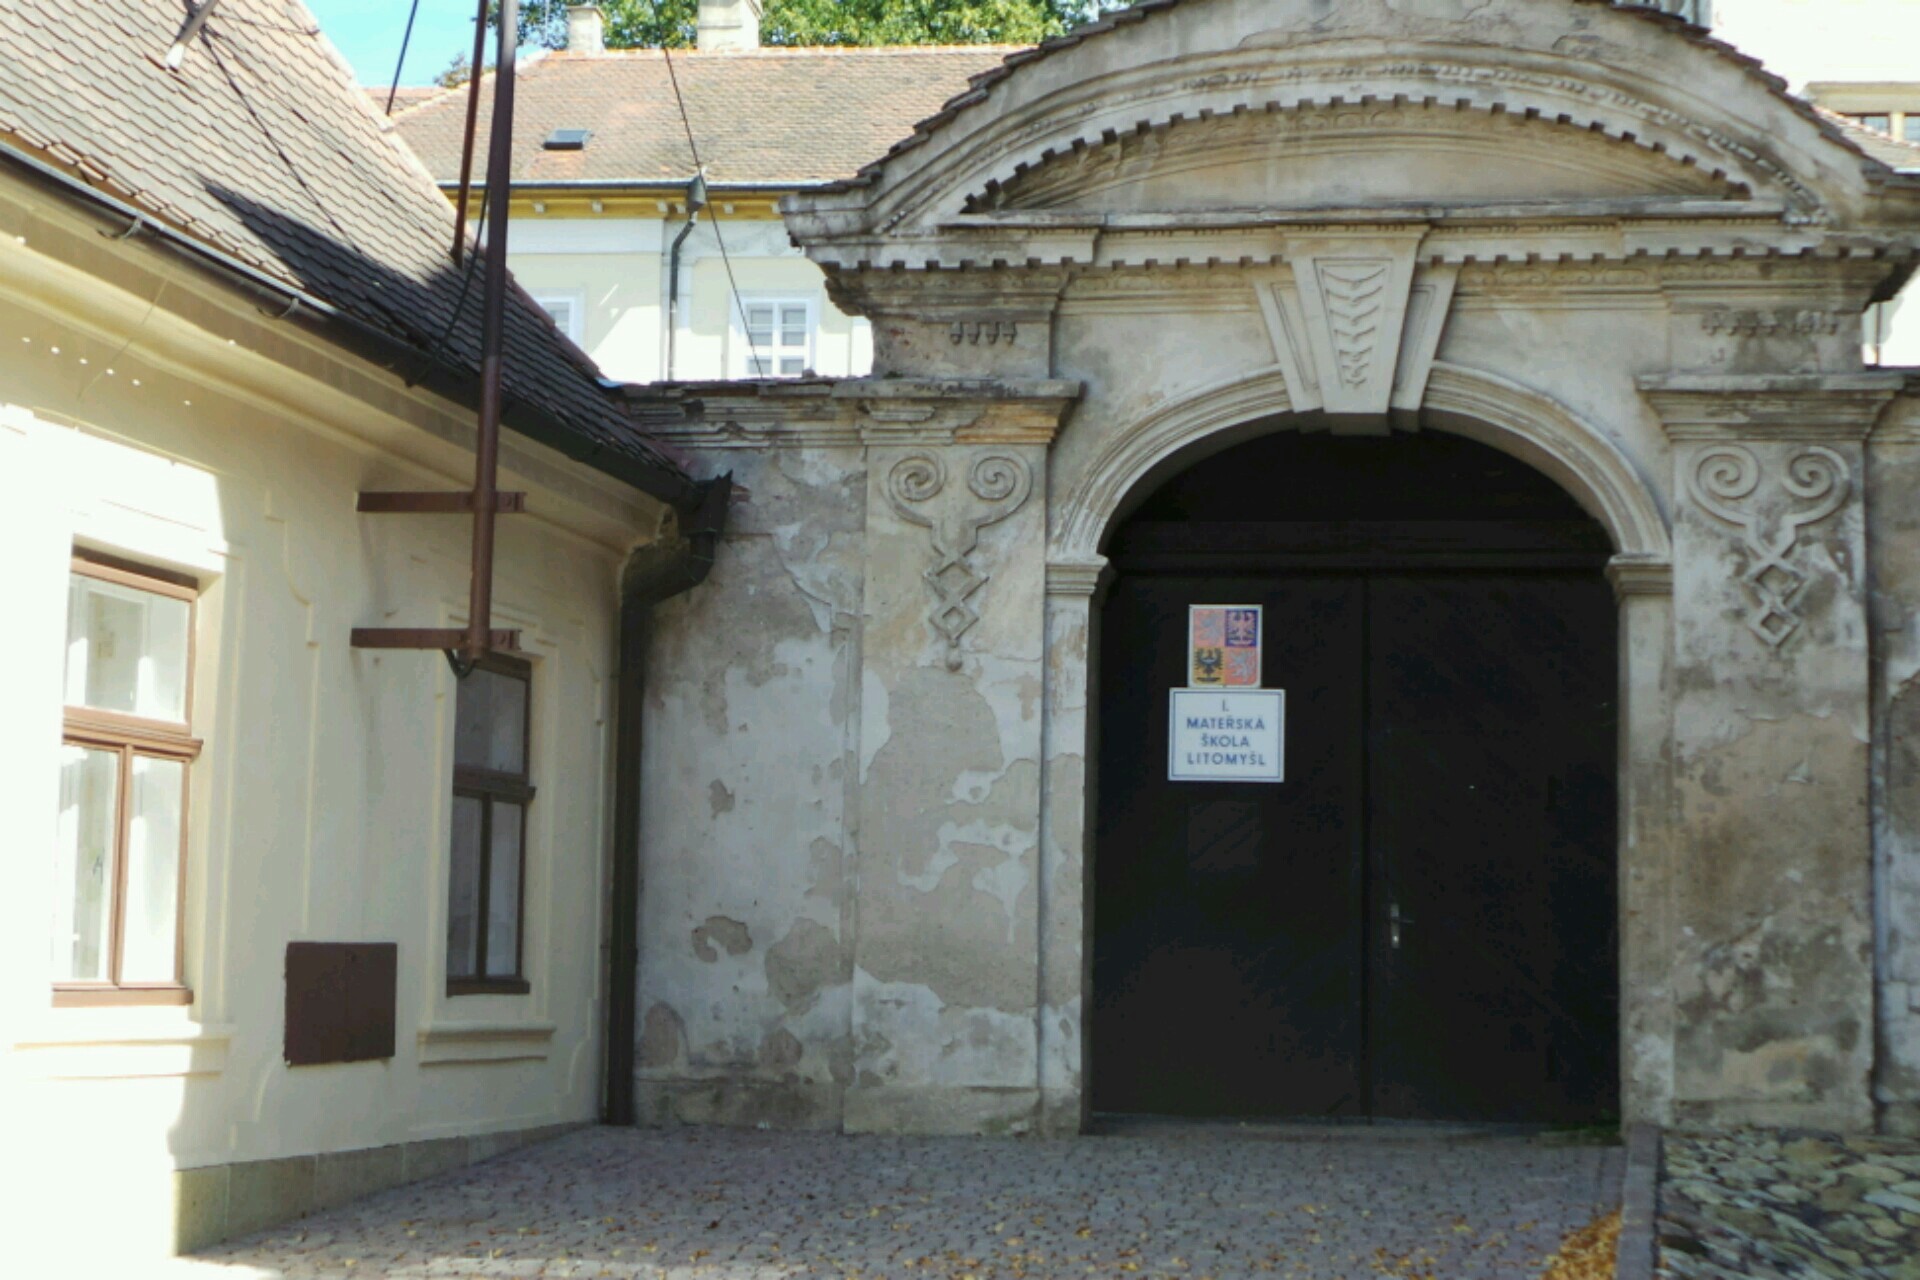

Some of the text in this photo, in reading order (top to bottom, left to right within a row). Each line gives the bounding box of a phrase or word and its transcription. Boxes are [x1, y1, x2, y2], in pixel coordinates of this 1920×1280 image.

[1222, 698, 1230, 712] I.
[1186, 715, 1265, 730] MATEŘSKÁ
[1201, 733, 1250, 747] ŠKOLA
[1187, 751, 1266, 766] LITOMYŠL
